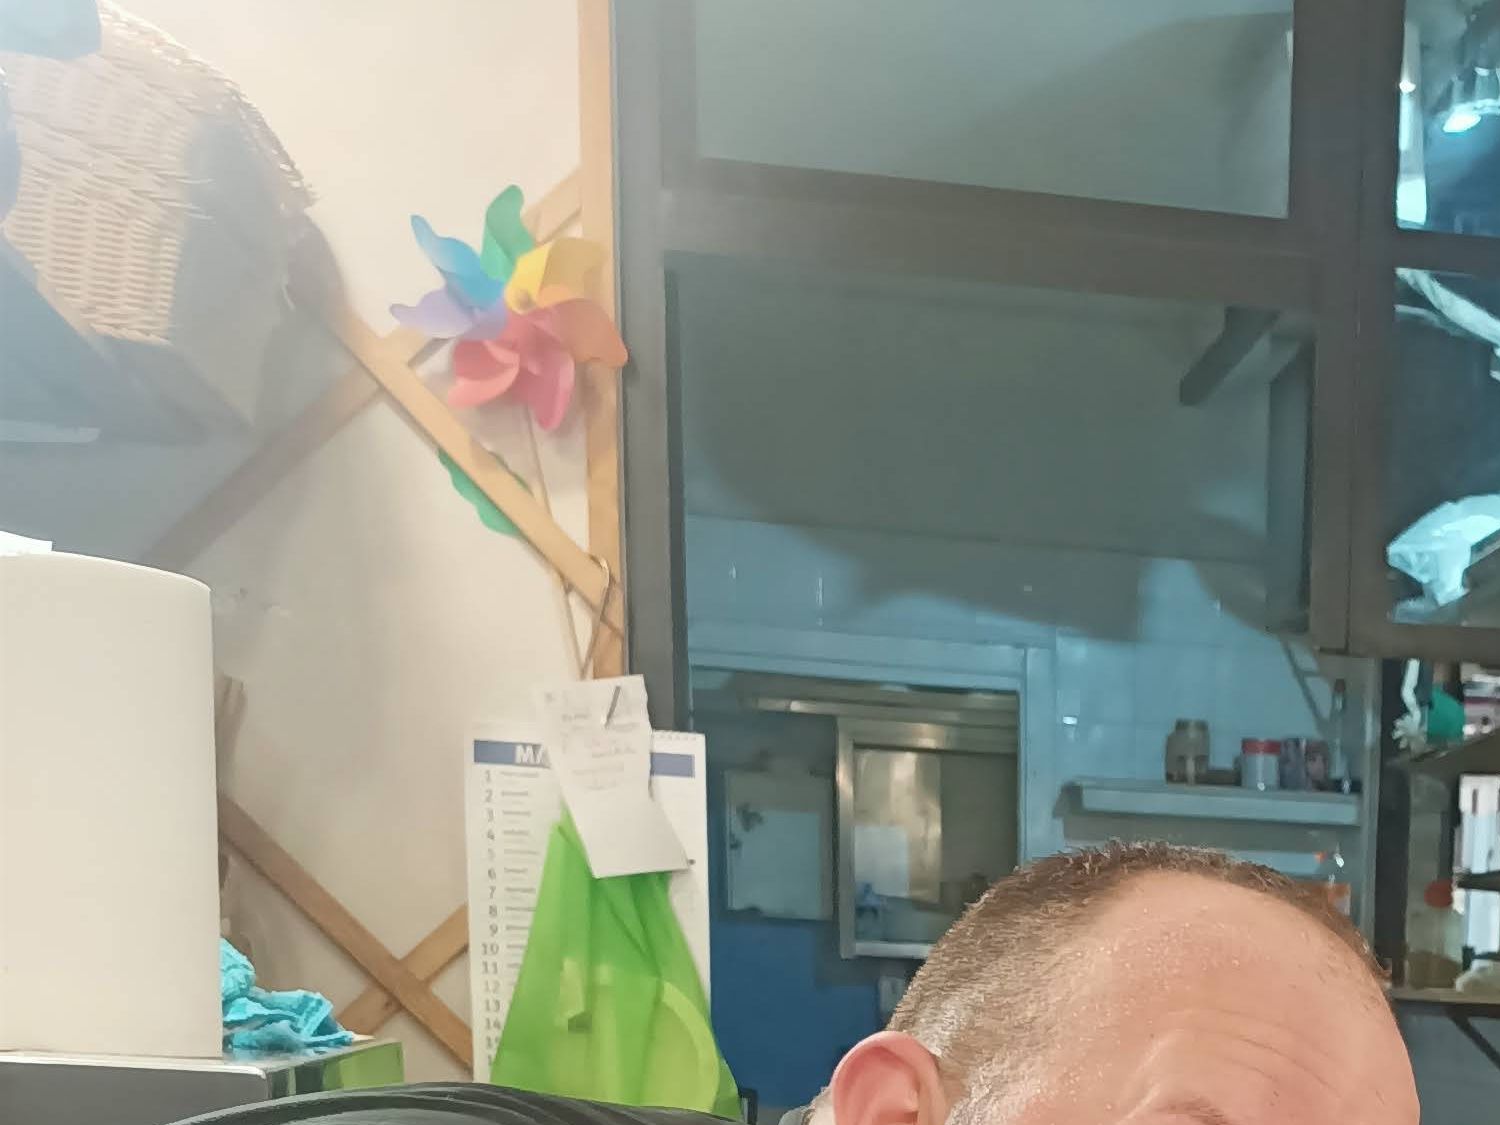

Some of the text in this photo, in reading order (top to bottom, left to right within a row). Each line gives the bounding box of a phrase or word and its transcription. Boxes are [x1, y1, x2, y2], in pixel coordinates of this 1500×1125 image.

[482, 943, 500, 956] 10
[482, 961, 499, 975] 11
[486, 999, 501, 1012] 13
